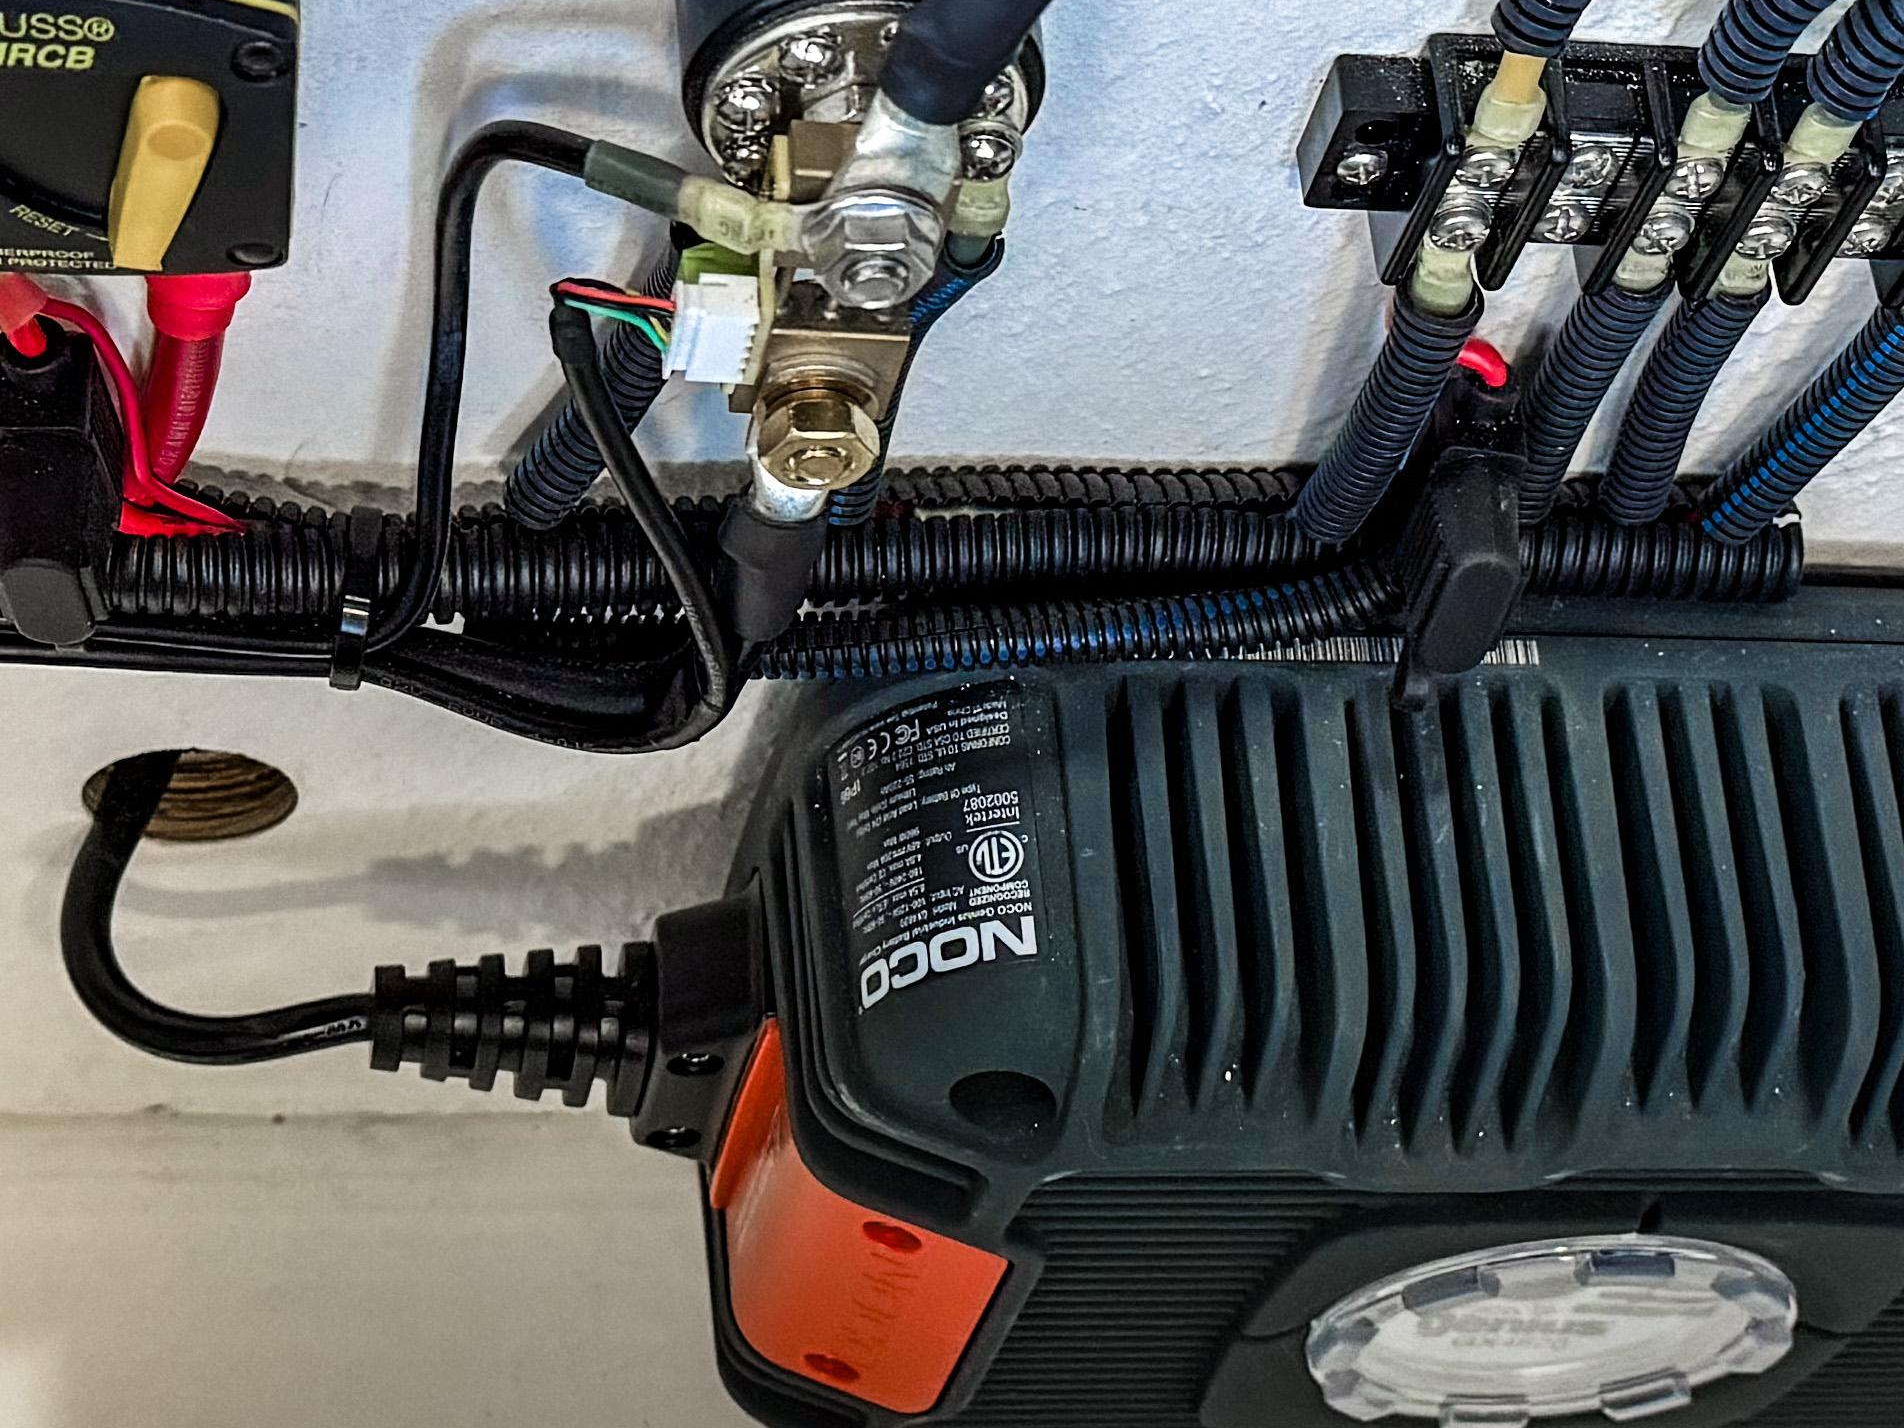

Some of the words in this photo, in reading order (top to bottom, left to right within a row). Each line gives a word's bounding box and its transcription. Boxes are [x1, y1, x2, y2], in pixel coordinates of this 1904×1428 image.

[8, 203, 81, 237] RESET
[960, 710, 1009, 723] Designed
[925, 722, 947, 736] USA
[952, 731, 964, 742] TO
[966, 722, 1010, 739] CERTIFIED
[934, 733, 951, 746] CSA
[961, 733, 1011, 752] CONFORMS
[947, 743, 959, 755] TO
[961, 783, 981, 795] Type
[962, 790, 1019, 813] 5002087
[965, 805, 1020, 826] Intertek
[968, 879, 1029, 898] COMPONENT
[968, 888, 1031, 907] RECOGNIZED
[957, 906, 995, 921] Genius
[996, 901, 1033, 916] NOCO
[860, 915, 1038, 1010] NOCO
